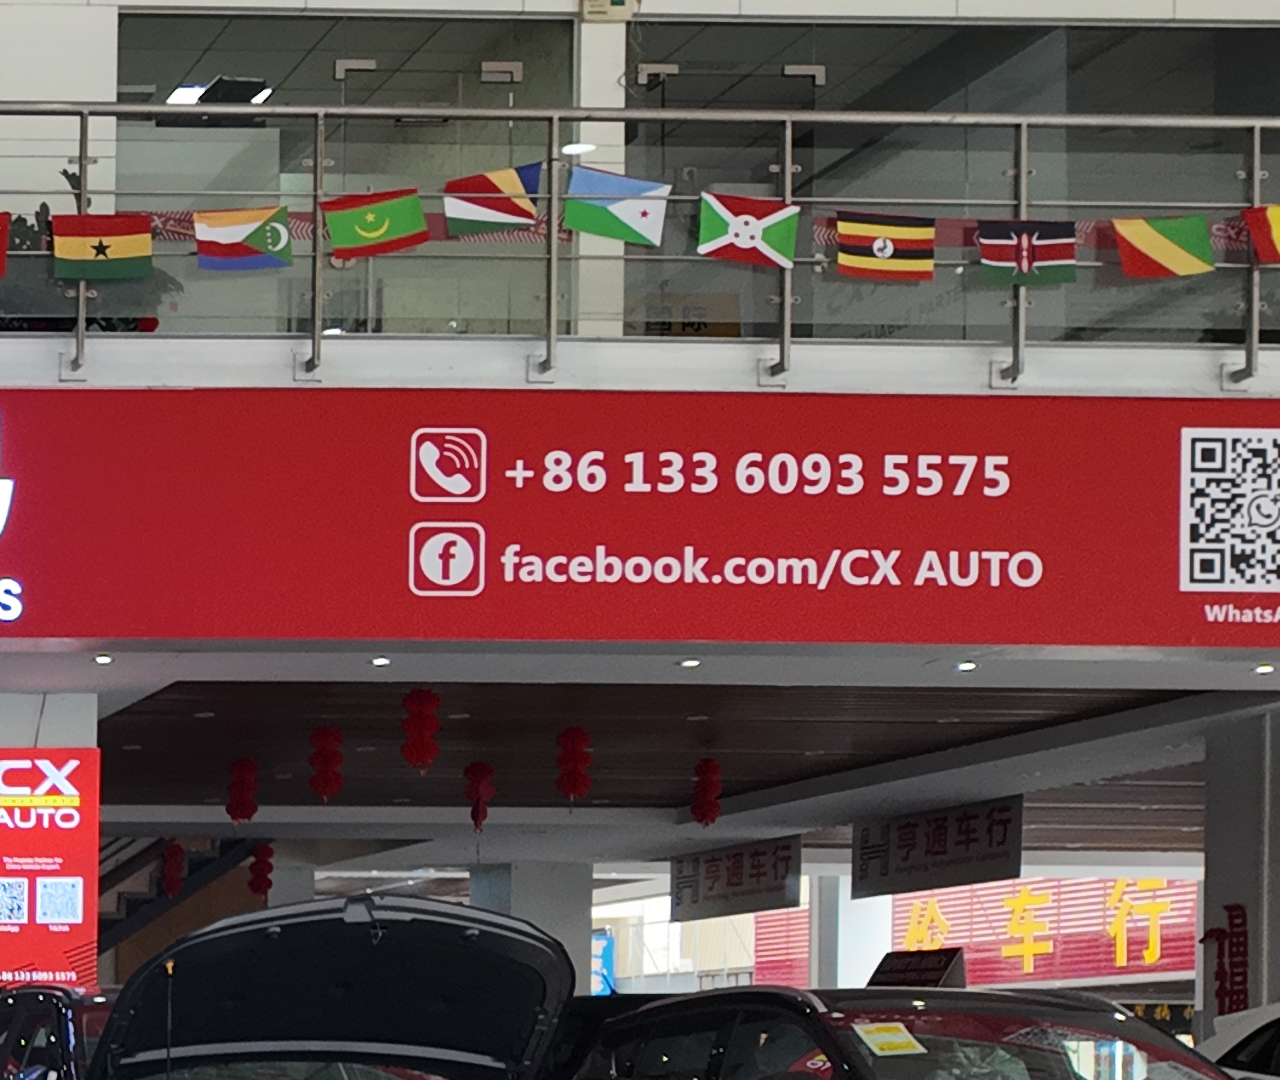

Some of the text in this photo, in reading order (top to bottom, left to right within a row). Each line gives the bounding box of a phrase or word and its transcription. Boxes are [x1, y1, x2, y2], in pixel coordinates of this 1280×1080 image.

[504, 450, 1010, 497] +86 133 6093 5575
[501, 545, 1043, 590] facebook.com/CX AUTO
